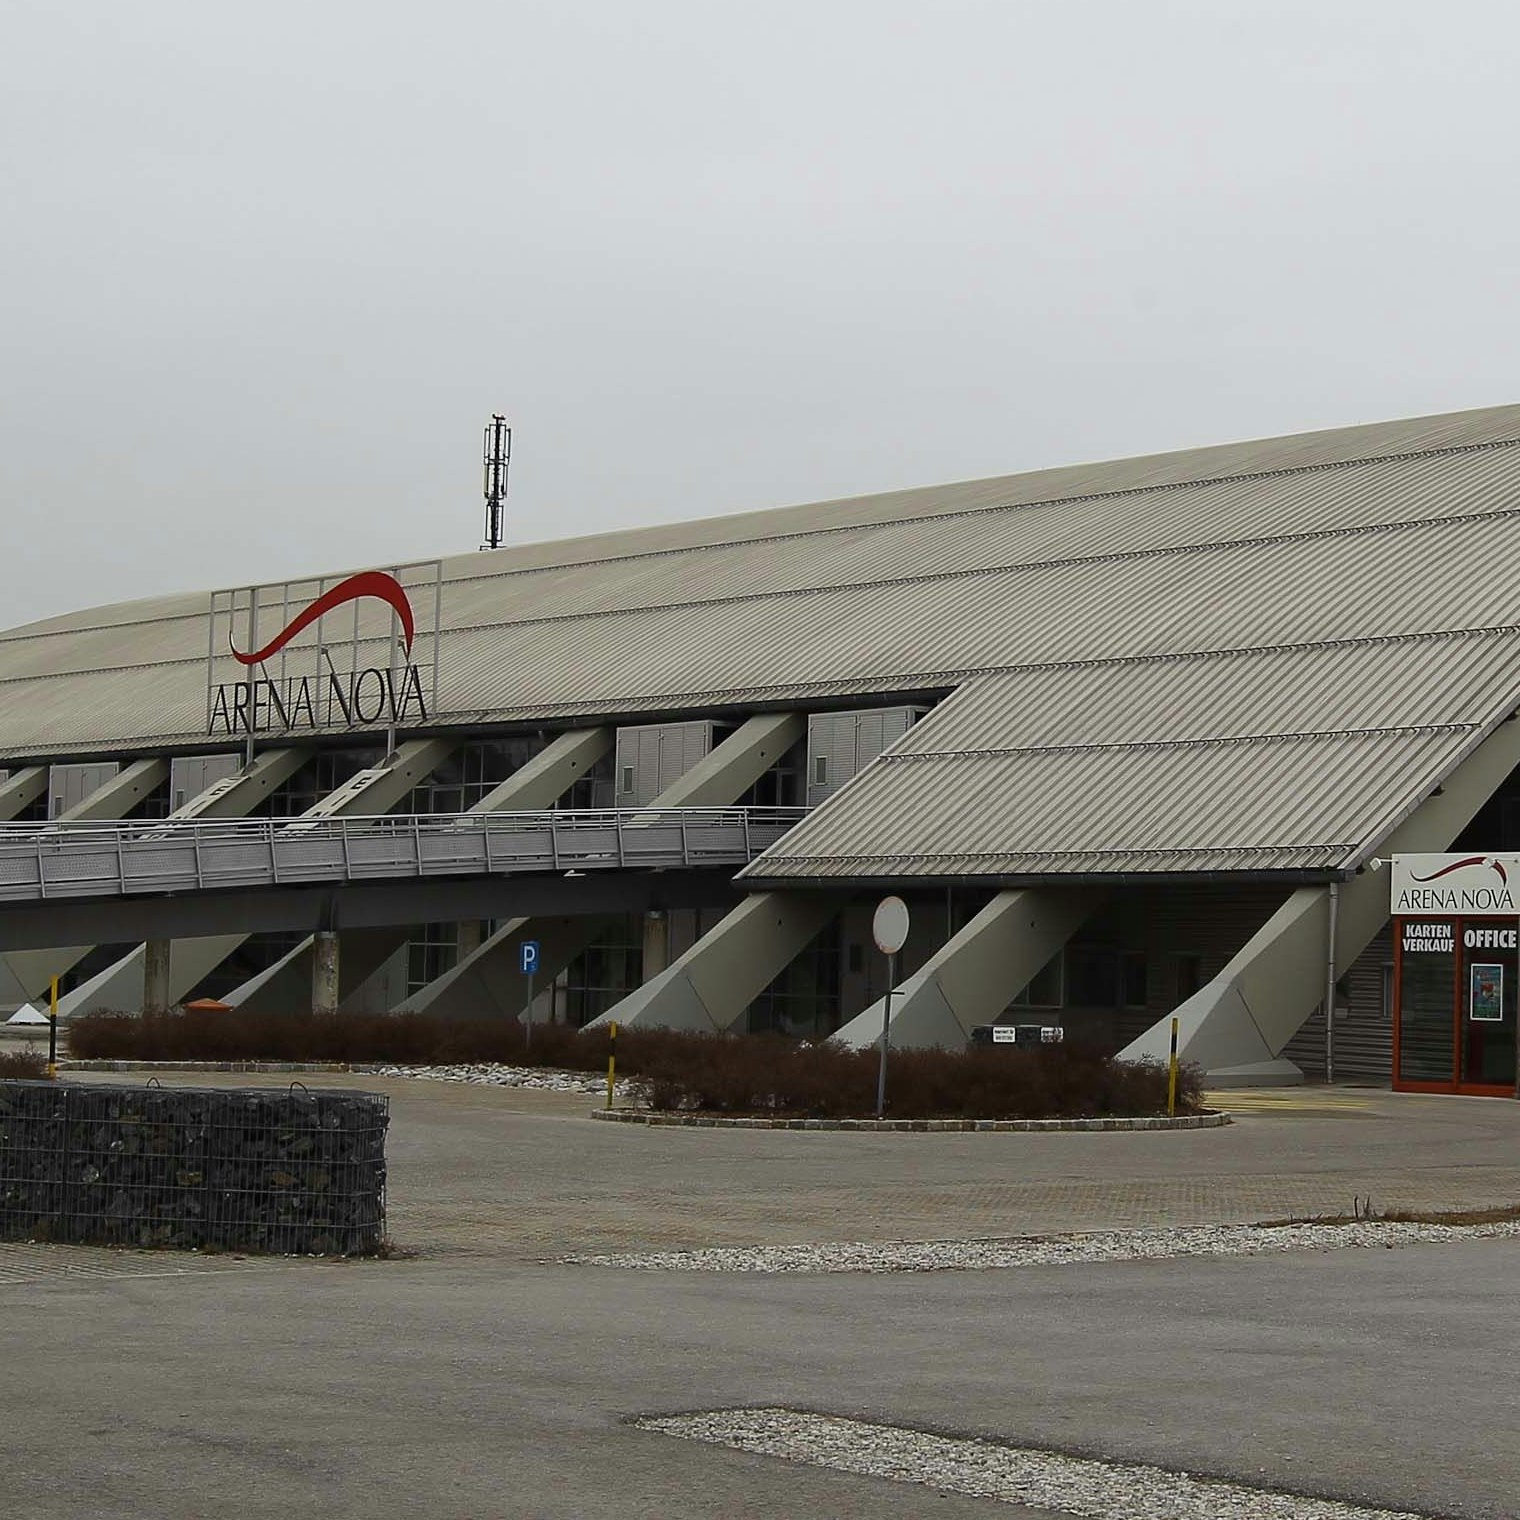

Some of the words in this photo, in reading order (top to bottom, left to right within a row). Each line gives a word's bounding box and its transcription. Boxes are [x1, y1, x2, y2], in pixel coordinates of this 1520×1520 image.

[208, 676, 316, 736] ARENA
[327, 664, 428, 728] NOVA
[1398, 888, 1459, 909] ARENA
[1460, 888, 1515, 909] NOVA
[1405, 924, 1452, 938] KARTEN
[1463, 929, 1518, 948] OFFICE
[1402, 938, 1455, 952] VERKAUF
[523, 945, 536, 971] P
